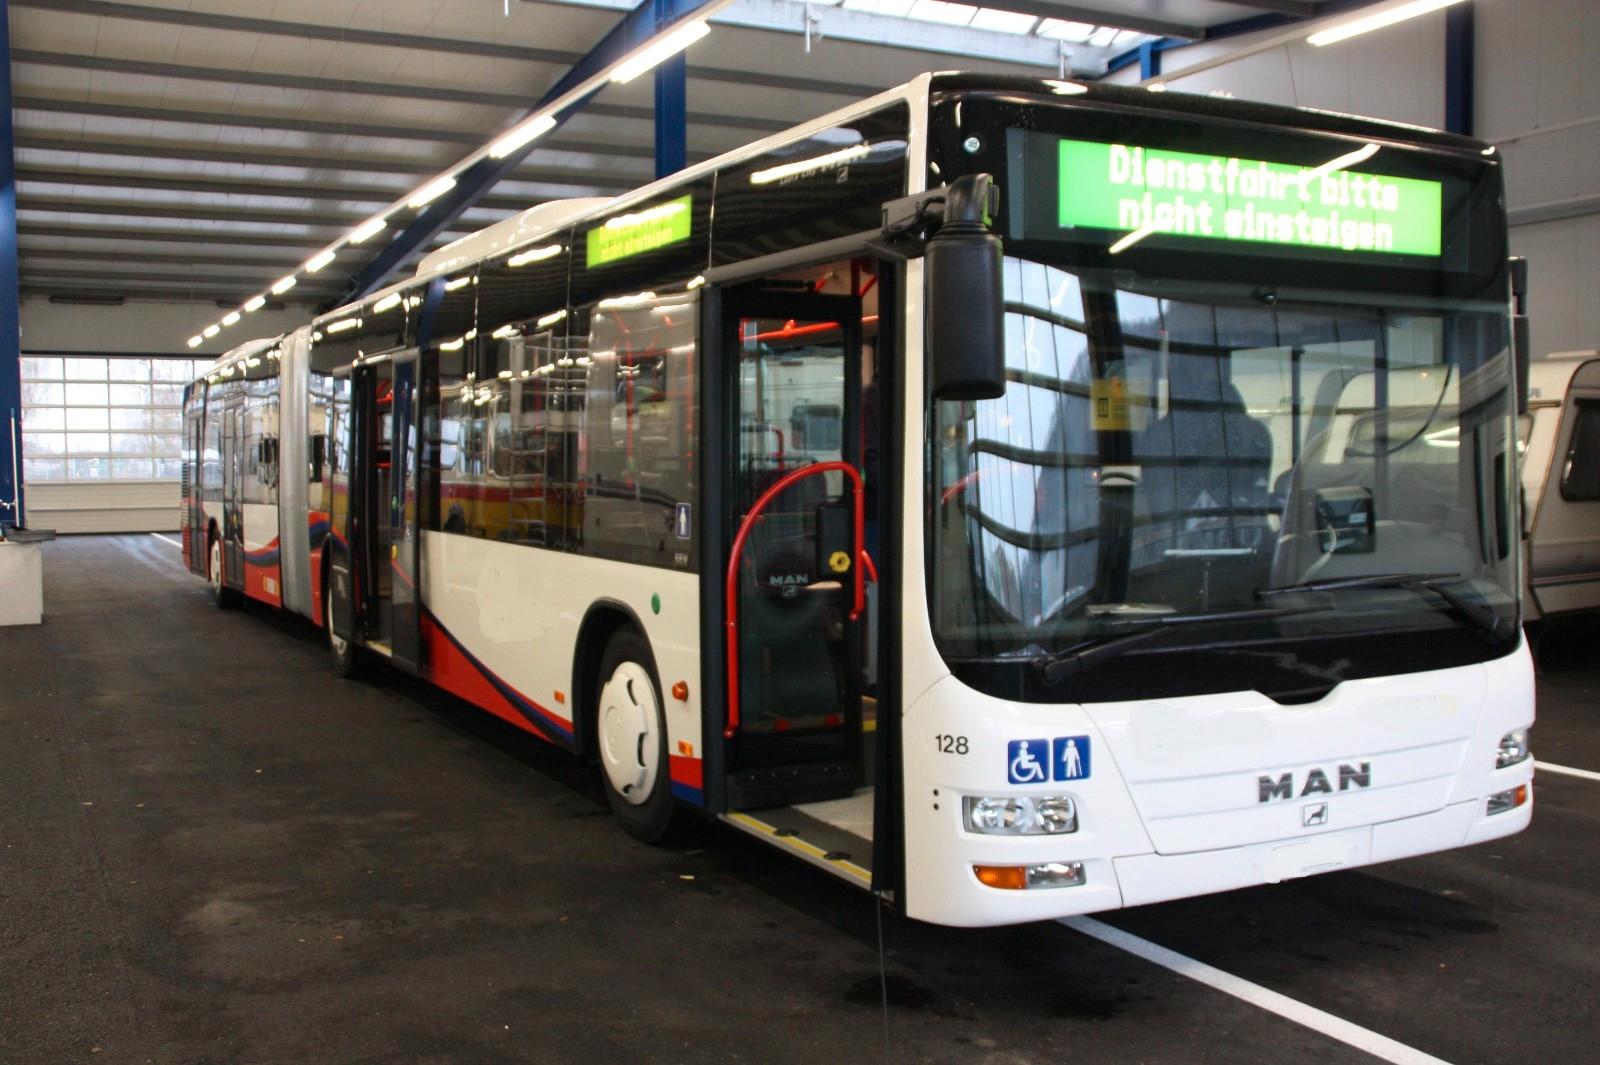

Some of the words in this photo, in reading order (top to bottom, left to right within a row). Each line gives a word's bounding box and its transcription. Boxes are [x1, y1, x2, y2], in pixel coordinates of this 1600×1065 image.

[1109, 144, 1311, 202] Dienstfahrt
[1320, 168, 1399, 211] bitte
[1119, 191, 1213, 234] nicht
[1224, 202, 1393, 252] einsteigen
[770, 575, 809, 585] MAN
[935, 734, 969, 755] 128
[1258, 761, 1371, 803] MAN
